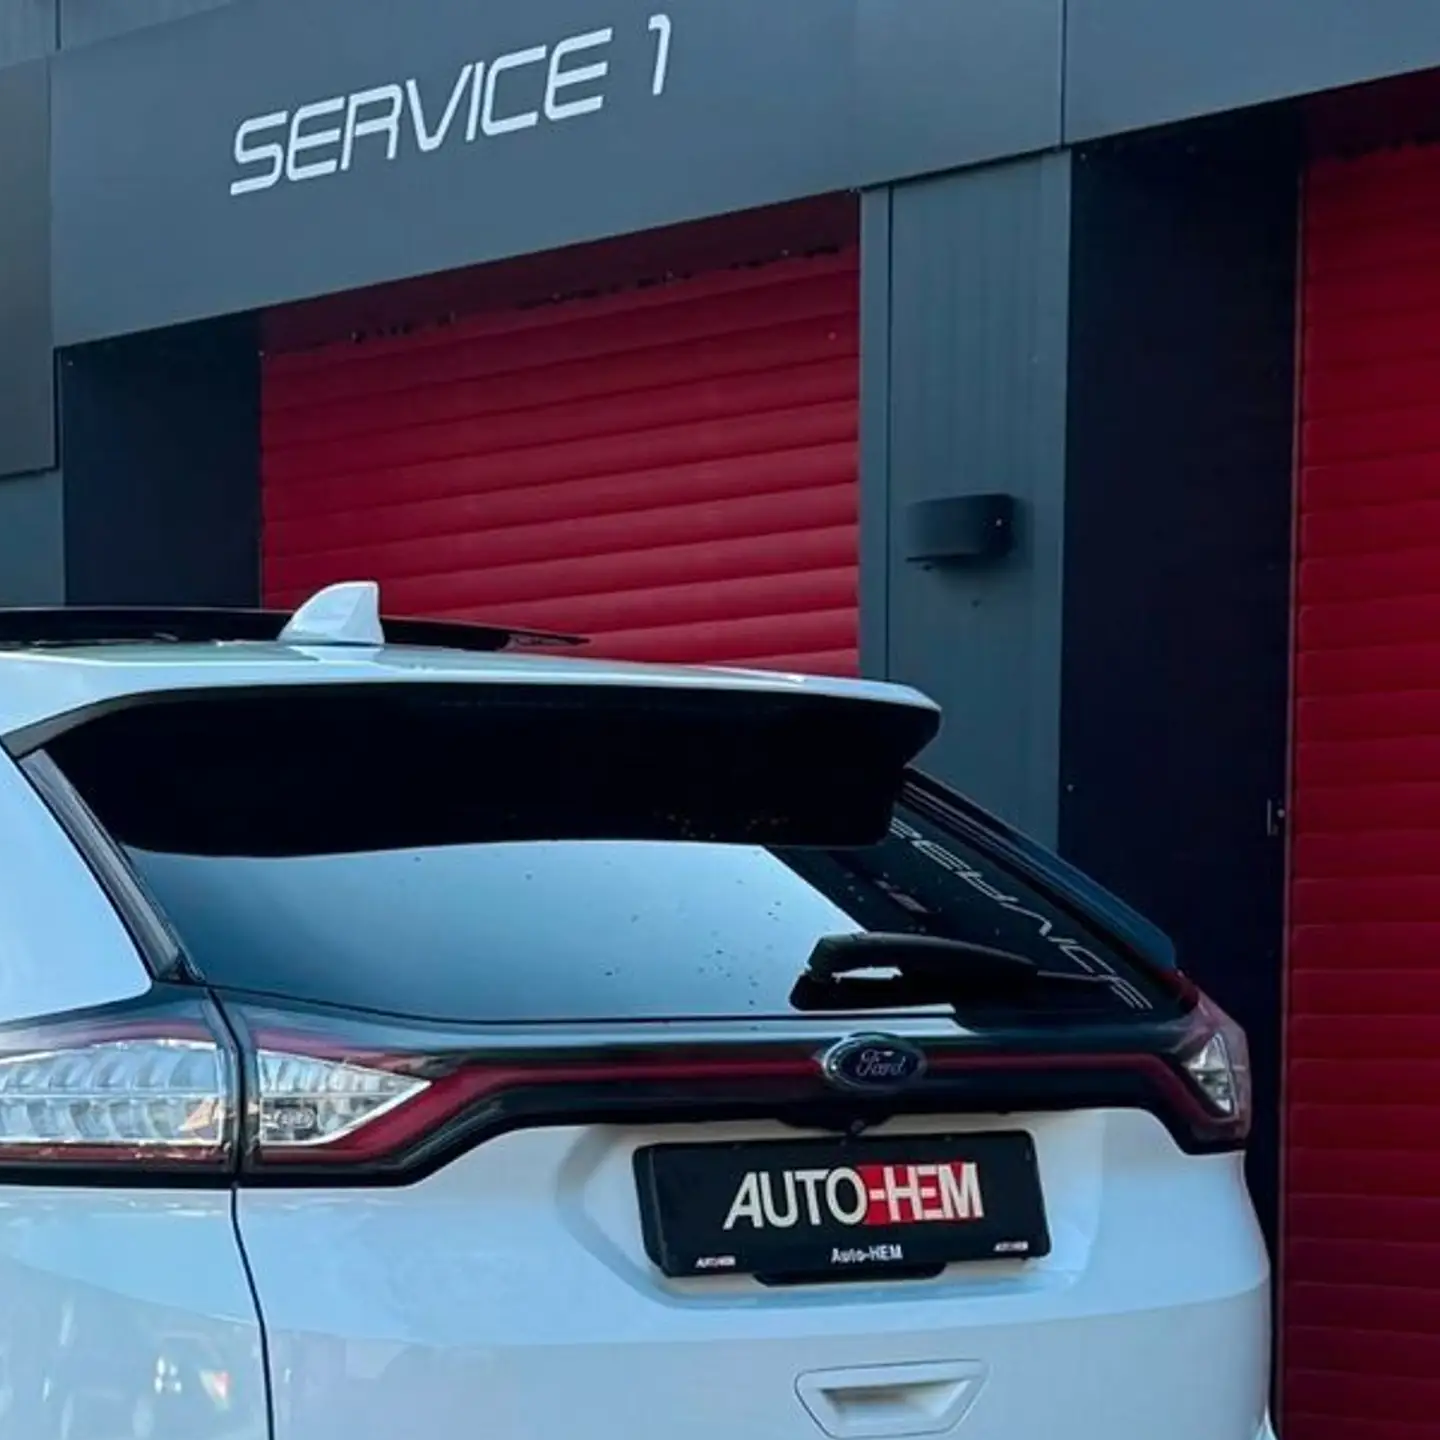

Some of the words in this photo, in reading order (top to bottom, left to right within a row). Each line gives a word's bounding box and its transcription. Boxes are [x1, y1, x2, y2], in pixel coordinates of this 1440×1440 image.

[230, 27, 613, 196] SERVICE
[648, 13, 672, 96] 1
[855, 1048, 907, 1077] Ford
[722, 1161, 985, 1231] AUTO-HEM
[831, 1243, 903, 1264] Auto-HEM
